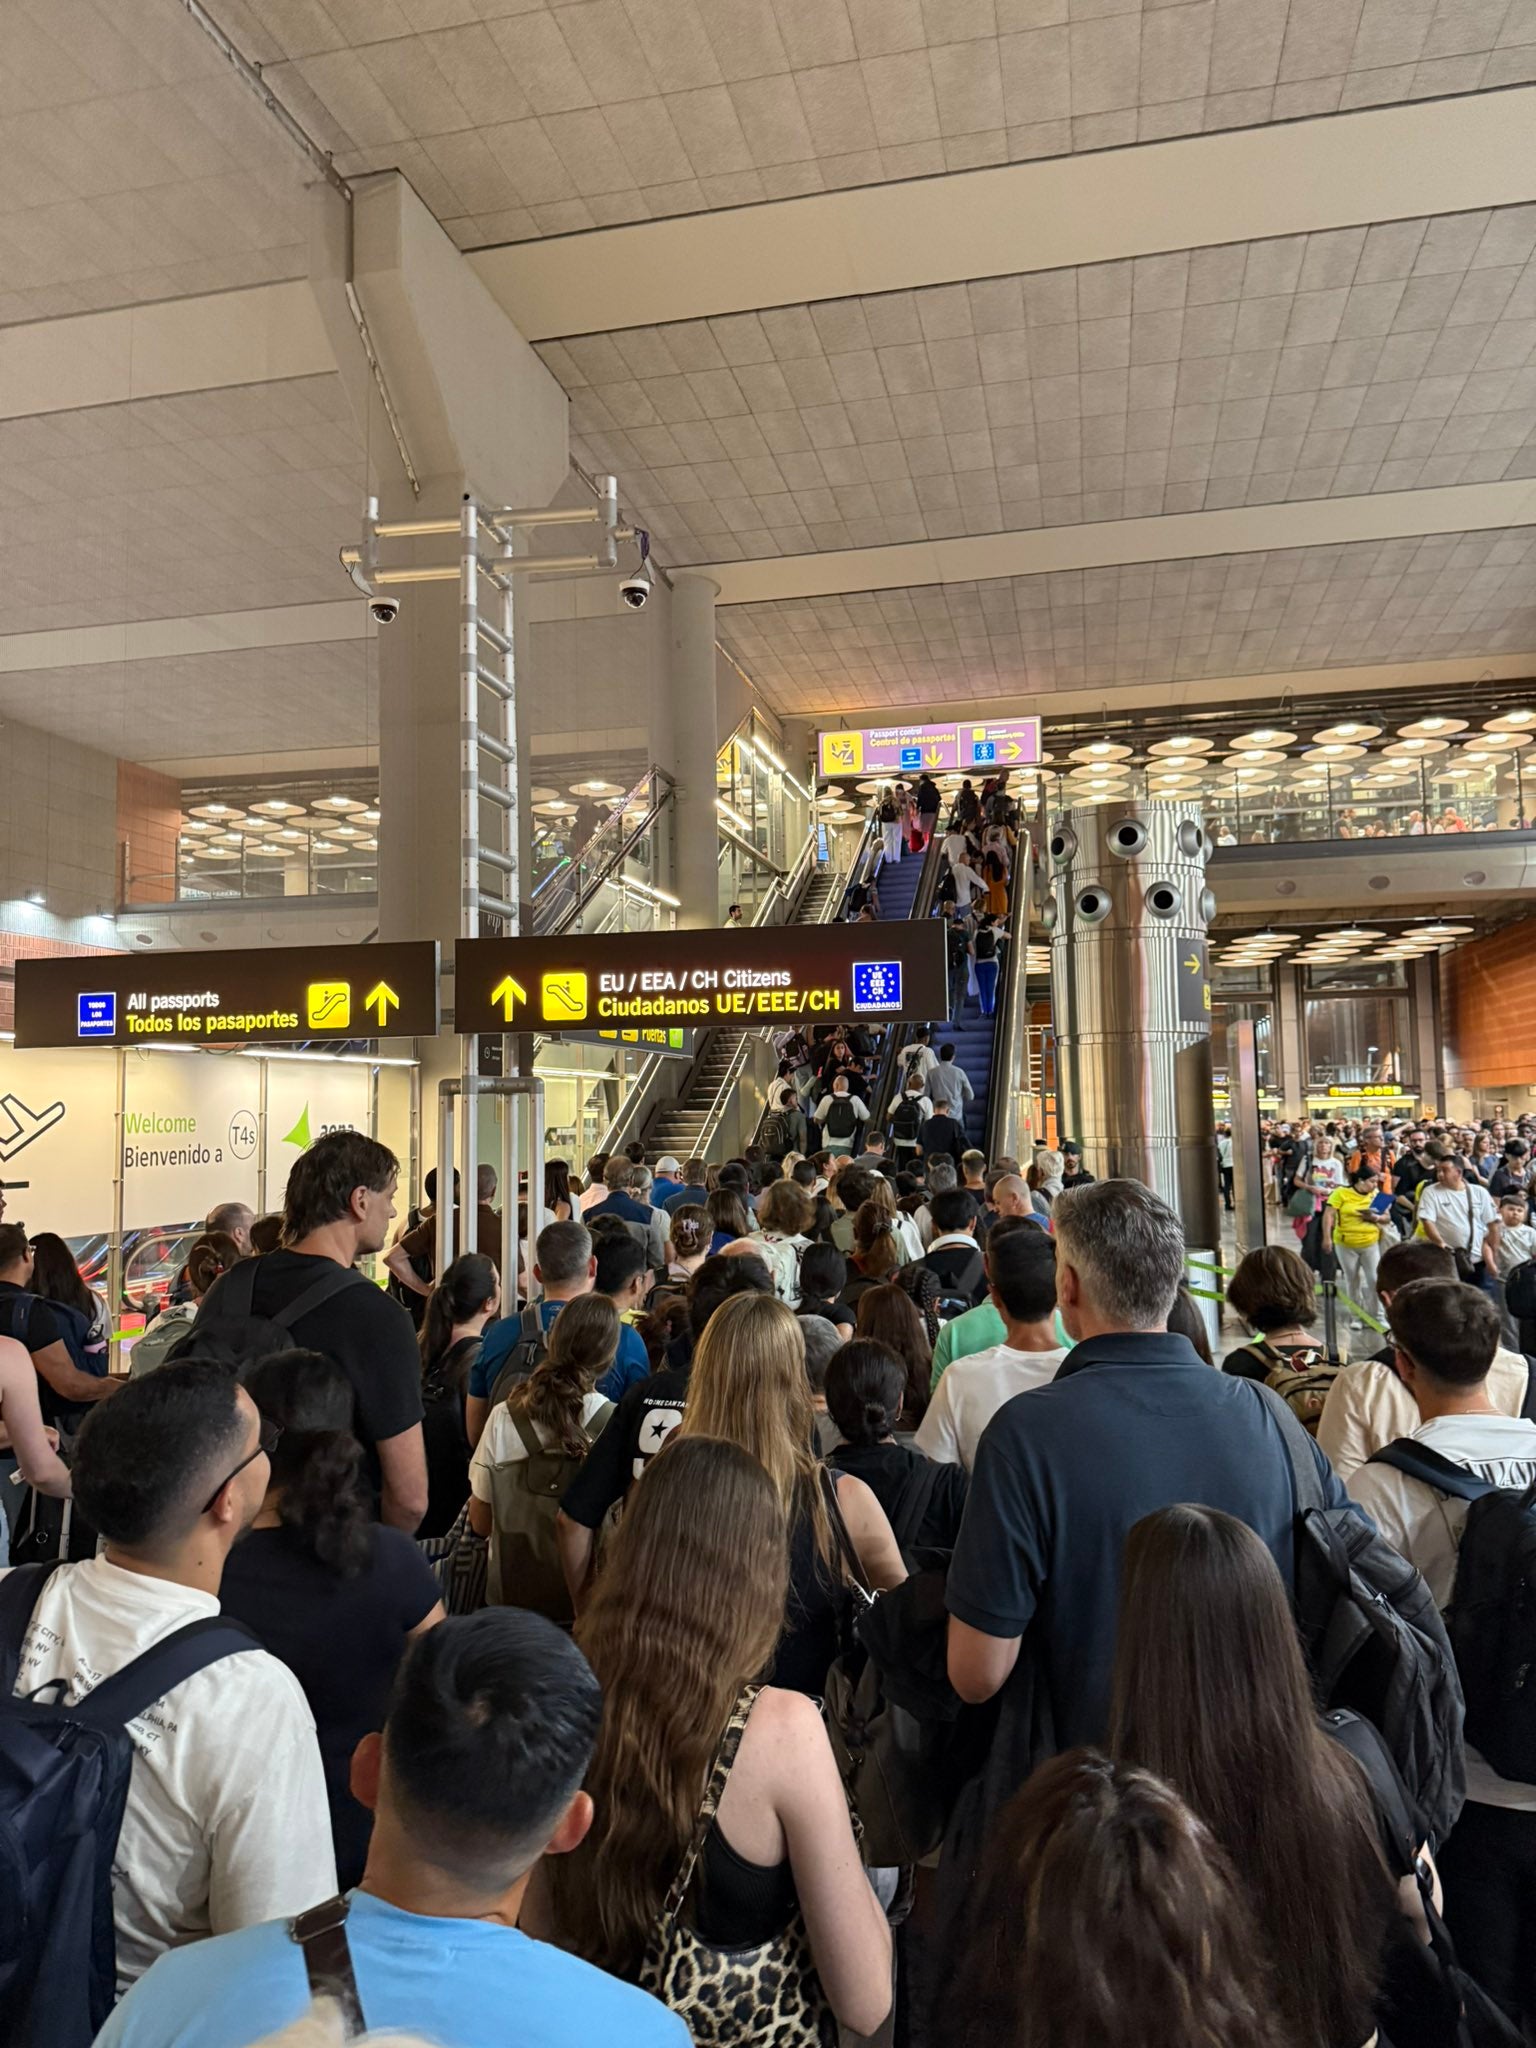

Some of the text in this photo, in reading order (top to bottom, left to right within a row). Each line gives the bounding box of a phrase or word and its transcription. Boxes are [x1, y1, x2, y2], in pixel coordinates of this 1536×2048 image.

[870, 727, 922, 738] Passport control
[870, 734, 956, 747] Control de pasaportes
[600, 969, 791, 993] EU / EEA / CH Citizens
[870, 979, 885, 987] EEE
[872, 971, 883, 980] UE
[872, 987, 884, 995] CH
[127, 991, 220, 1012] All passports
[598, 989, 840, 1017] Ciudadanos UE/EEE/CH
[856, 1001, 901, 1009] CIUDADANOS
[126, 1010, 299, 1034] Todos los pasaportes
[641, 1029, 667, 1044] Puertas
[125, 1111, 197, 1134] Welcome
[232, 1126, 256, 1146] T4s
[125, 1144, 223, 1168] Bienvenido a
[141, 1712, 165, 1729] LPHIA,
